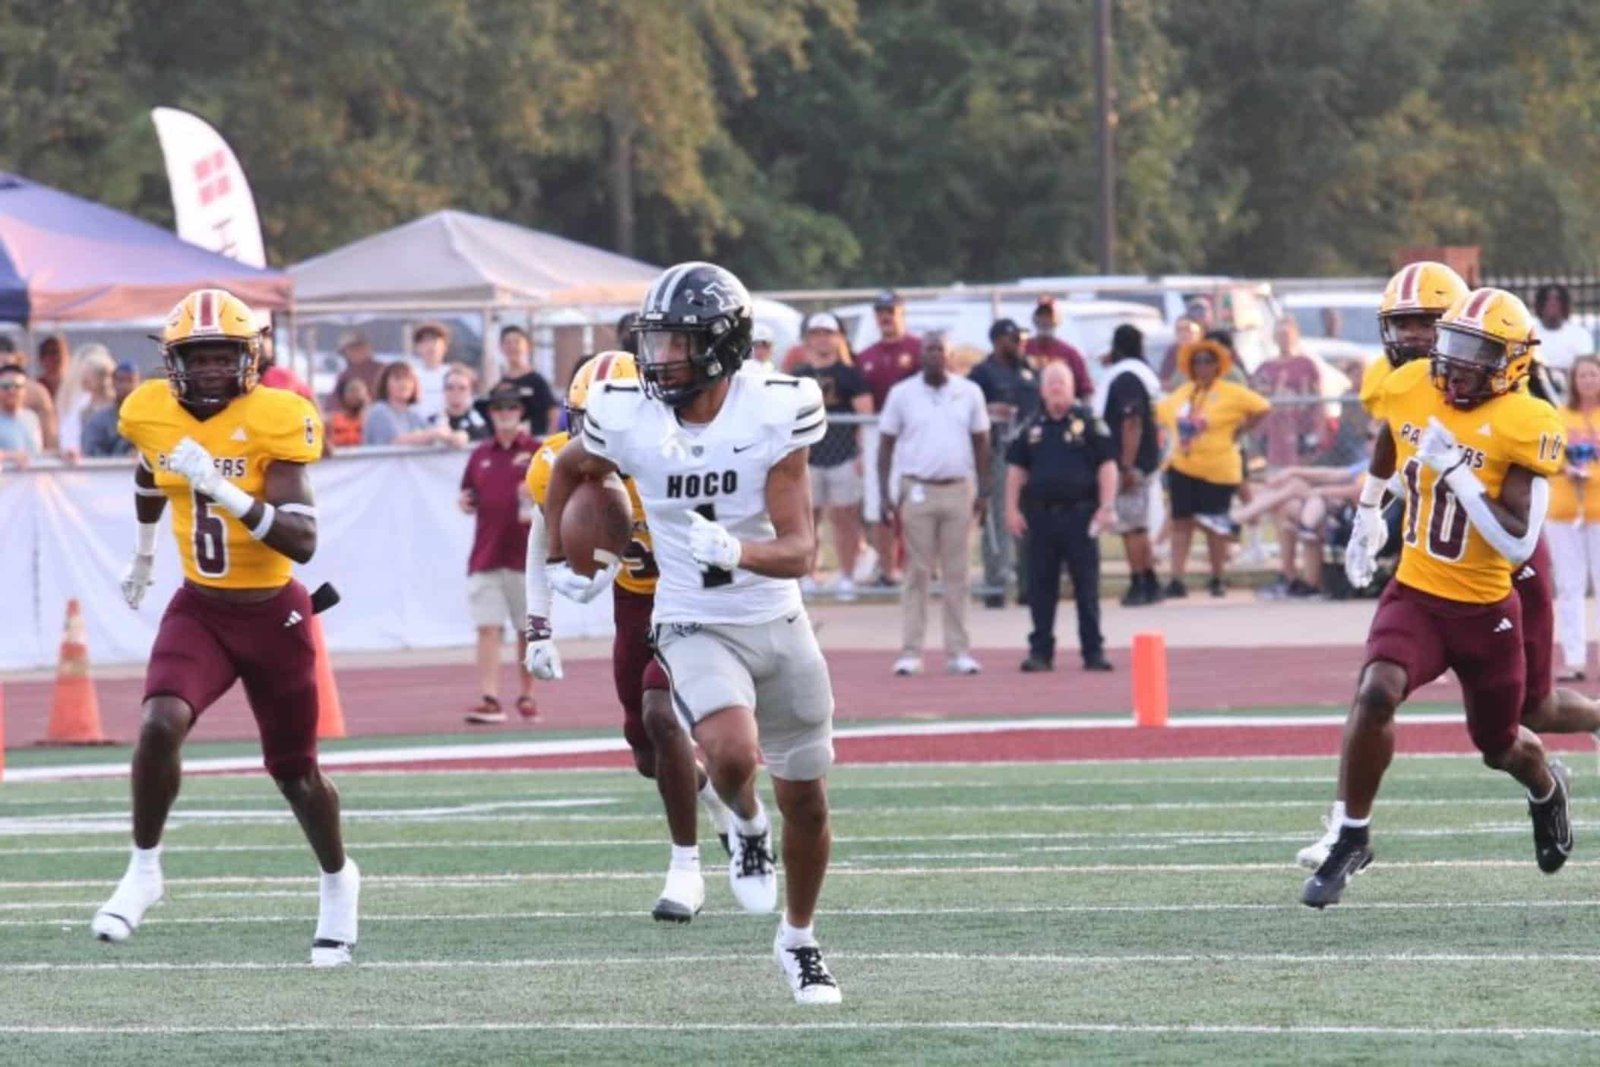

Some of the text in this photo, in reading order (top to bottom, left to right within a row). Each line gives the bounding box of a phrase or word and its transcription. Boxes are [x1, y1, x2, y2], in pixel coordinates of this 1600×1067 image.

[667, 469, 738, 499] HOCO
[1403, 457, 1470, 562] 10
[192, 487, 229, 577] 6
